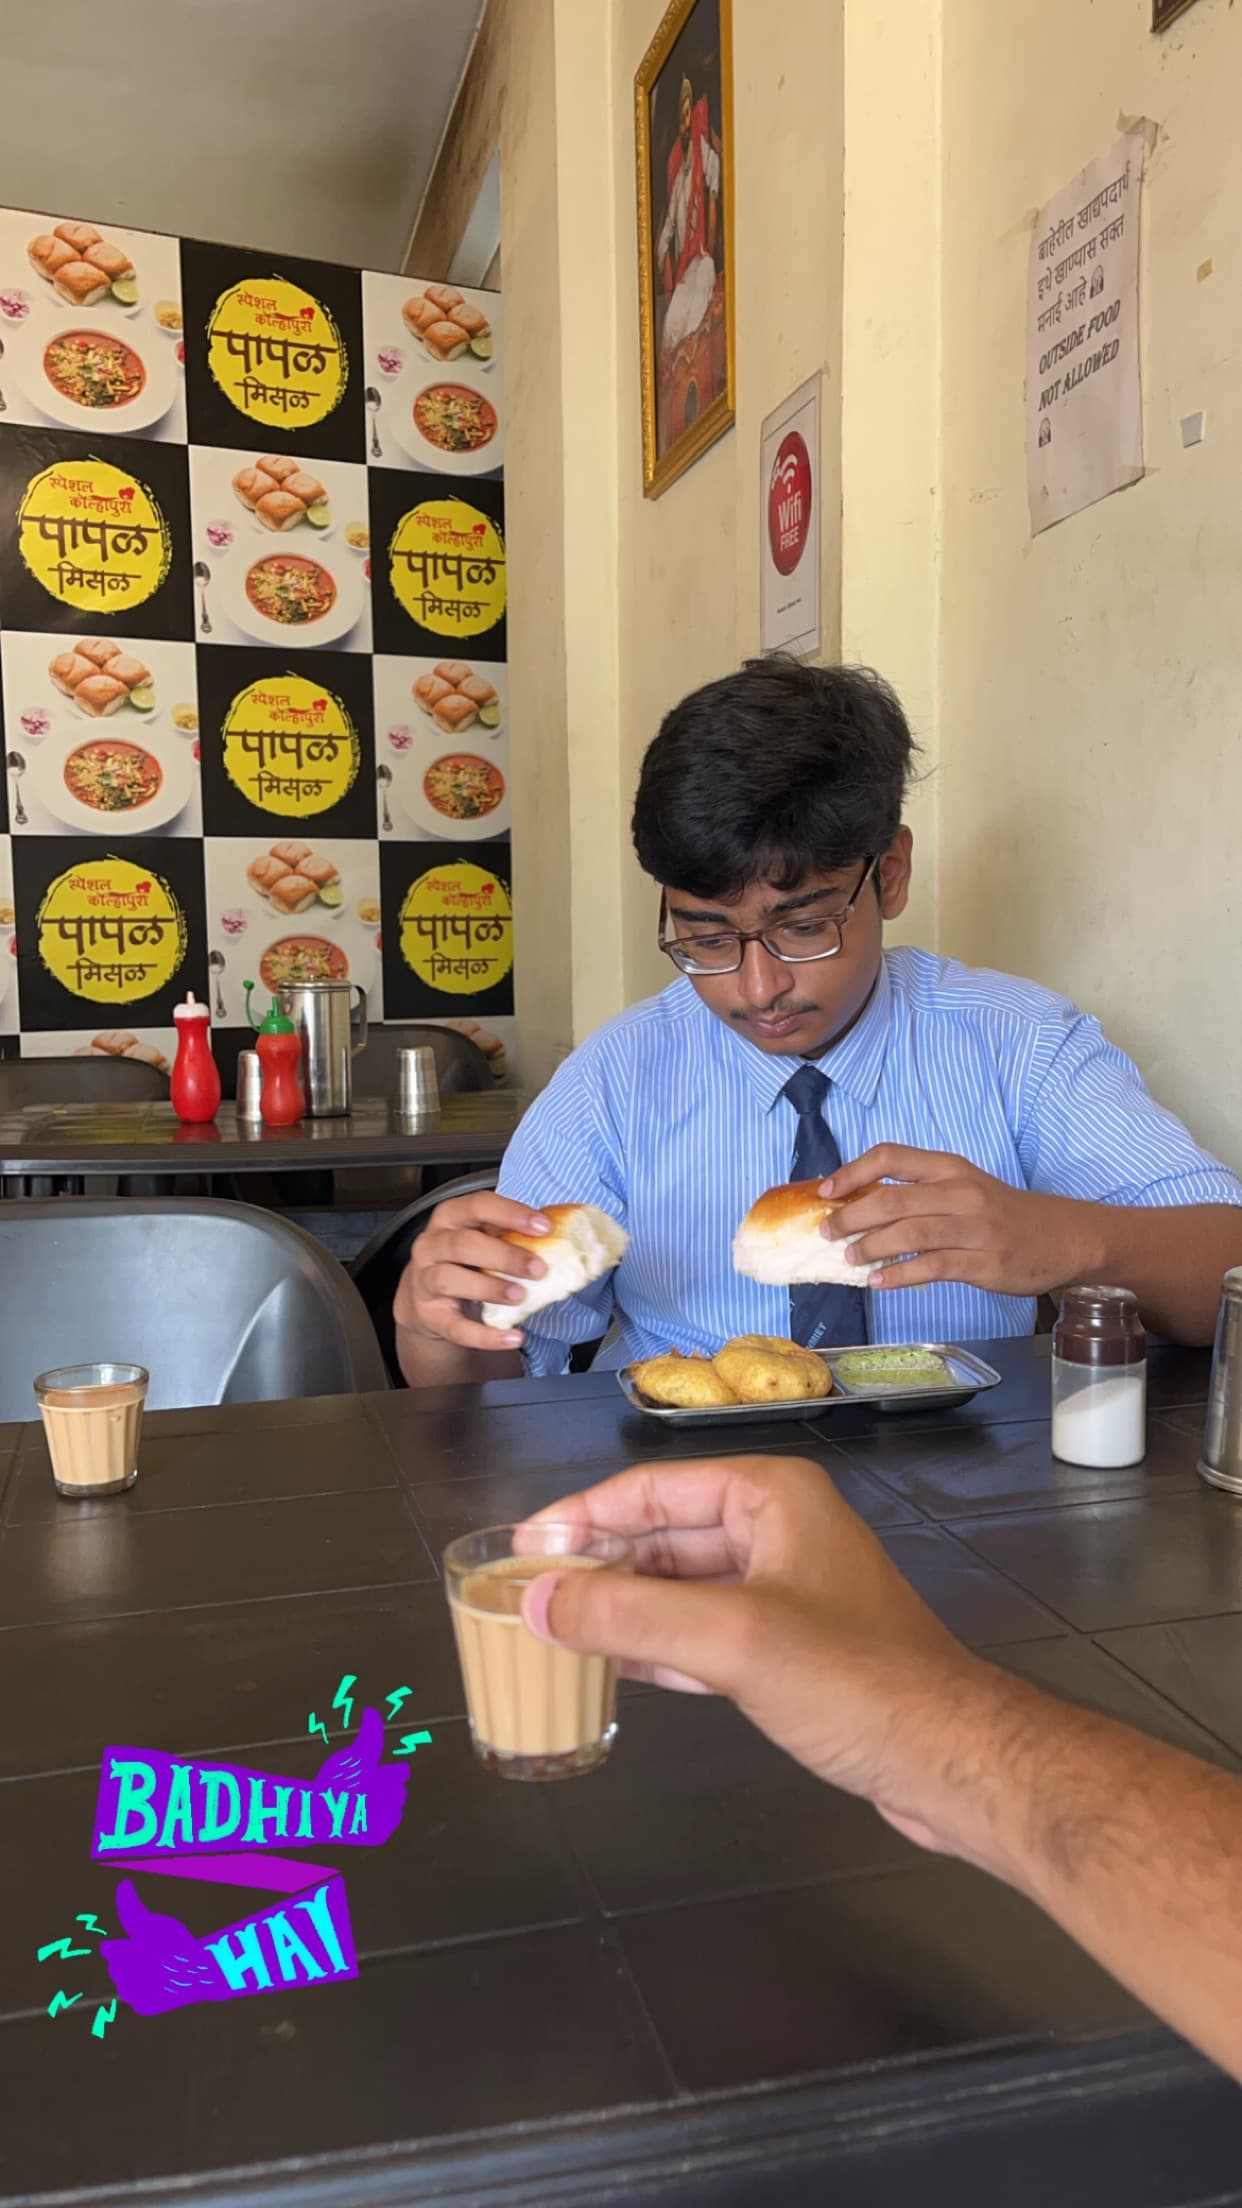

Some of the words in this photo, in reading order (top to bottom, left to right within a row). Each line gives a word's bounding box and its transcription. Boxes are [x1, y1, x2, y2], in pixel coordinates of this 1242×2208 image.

[1037, 266, 1053, 300] इथे
[1054, 236, 1097, 285] खाण्यास
[1099, 214, 1125, 250] सक्त
[1038, 217, 1075, 261] बाहेरील
[237, 291, 277, 310] स्पेशल
[1037, 291, 1063, 332] मनाई
[1065, 276, 1087, 311] आहे
[212, 330, 337, 378] पापळ
[1039, 324, 1086, 375] OUTSIDE
[1087, 299, 1120, 340] FOOD
[234, 376, 320, 413] मिसळ
[1038, 379, 1062, 412] NOT
[1062, 339, 1120, 395] ALLOWED
[50, 474, 94, 492] स्पेशल
[22, 515, 159, 562] पापळ
[781, 525, 799, 552] FREE
[48, 561, 141, 597] मिसळ
[392, 550, 505, 591] पापळ
[413, 590, 491, 622] मिसळ
[227, 729, 348, 770] पापळ
[248, 770, 332, 802] मिसळ
[42, 915, 175, 956] पापळ
[402, 914, 512, 951] पापळ
[66, 957, 158, 990] मिसळ
[422, 952, 498, 981] मिसळ
